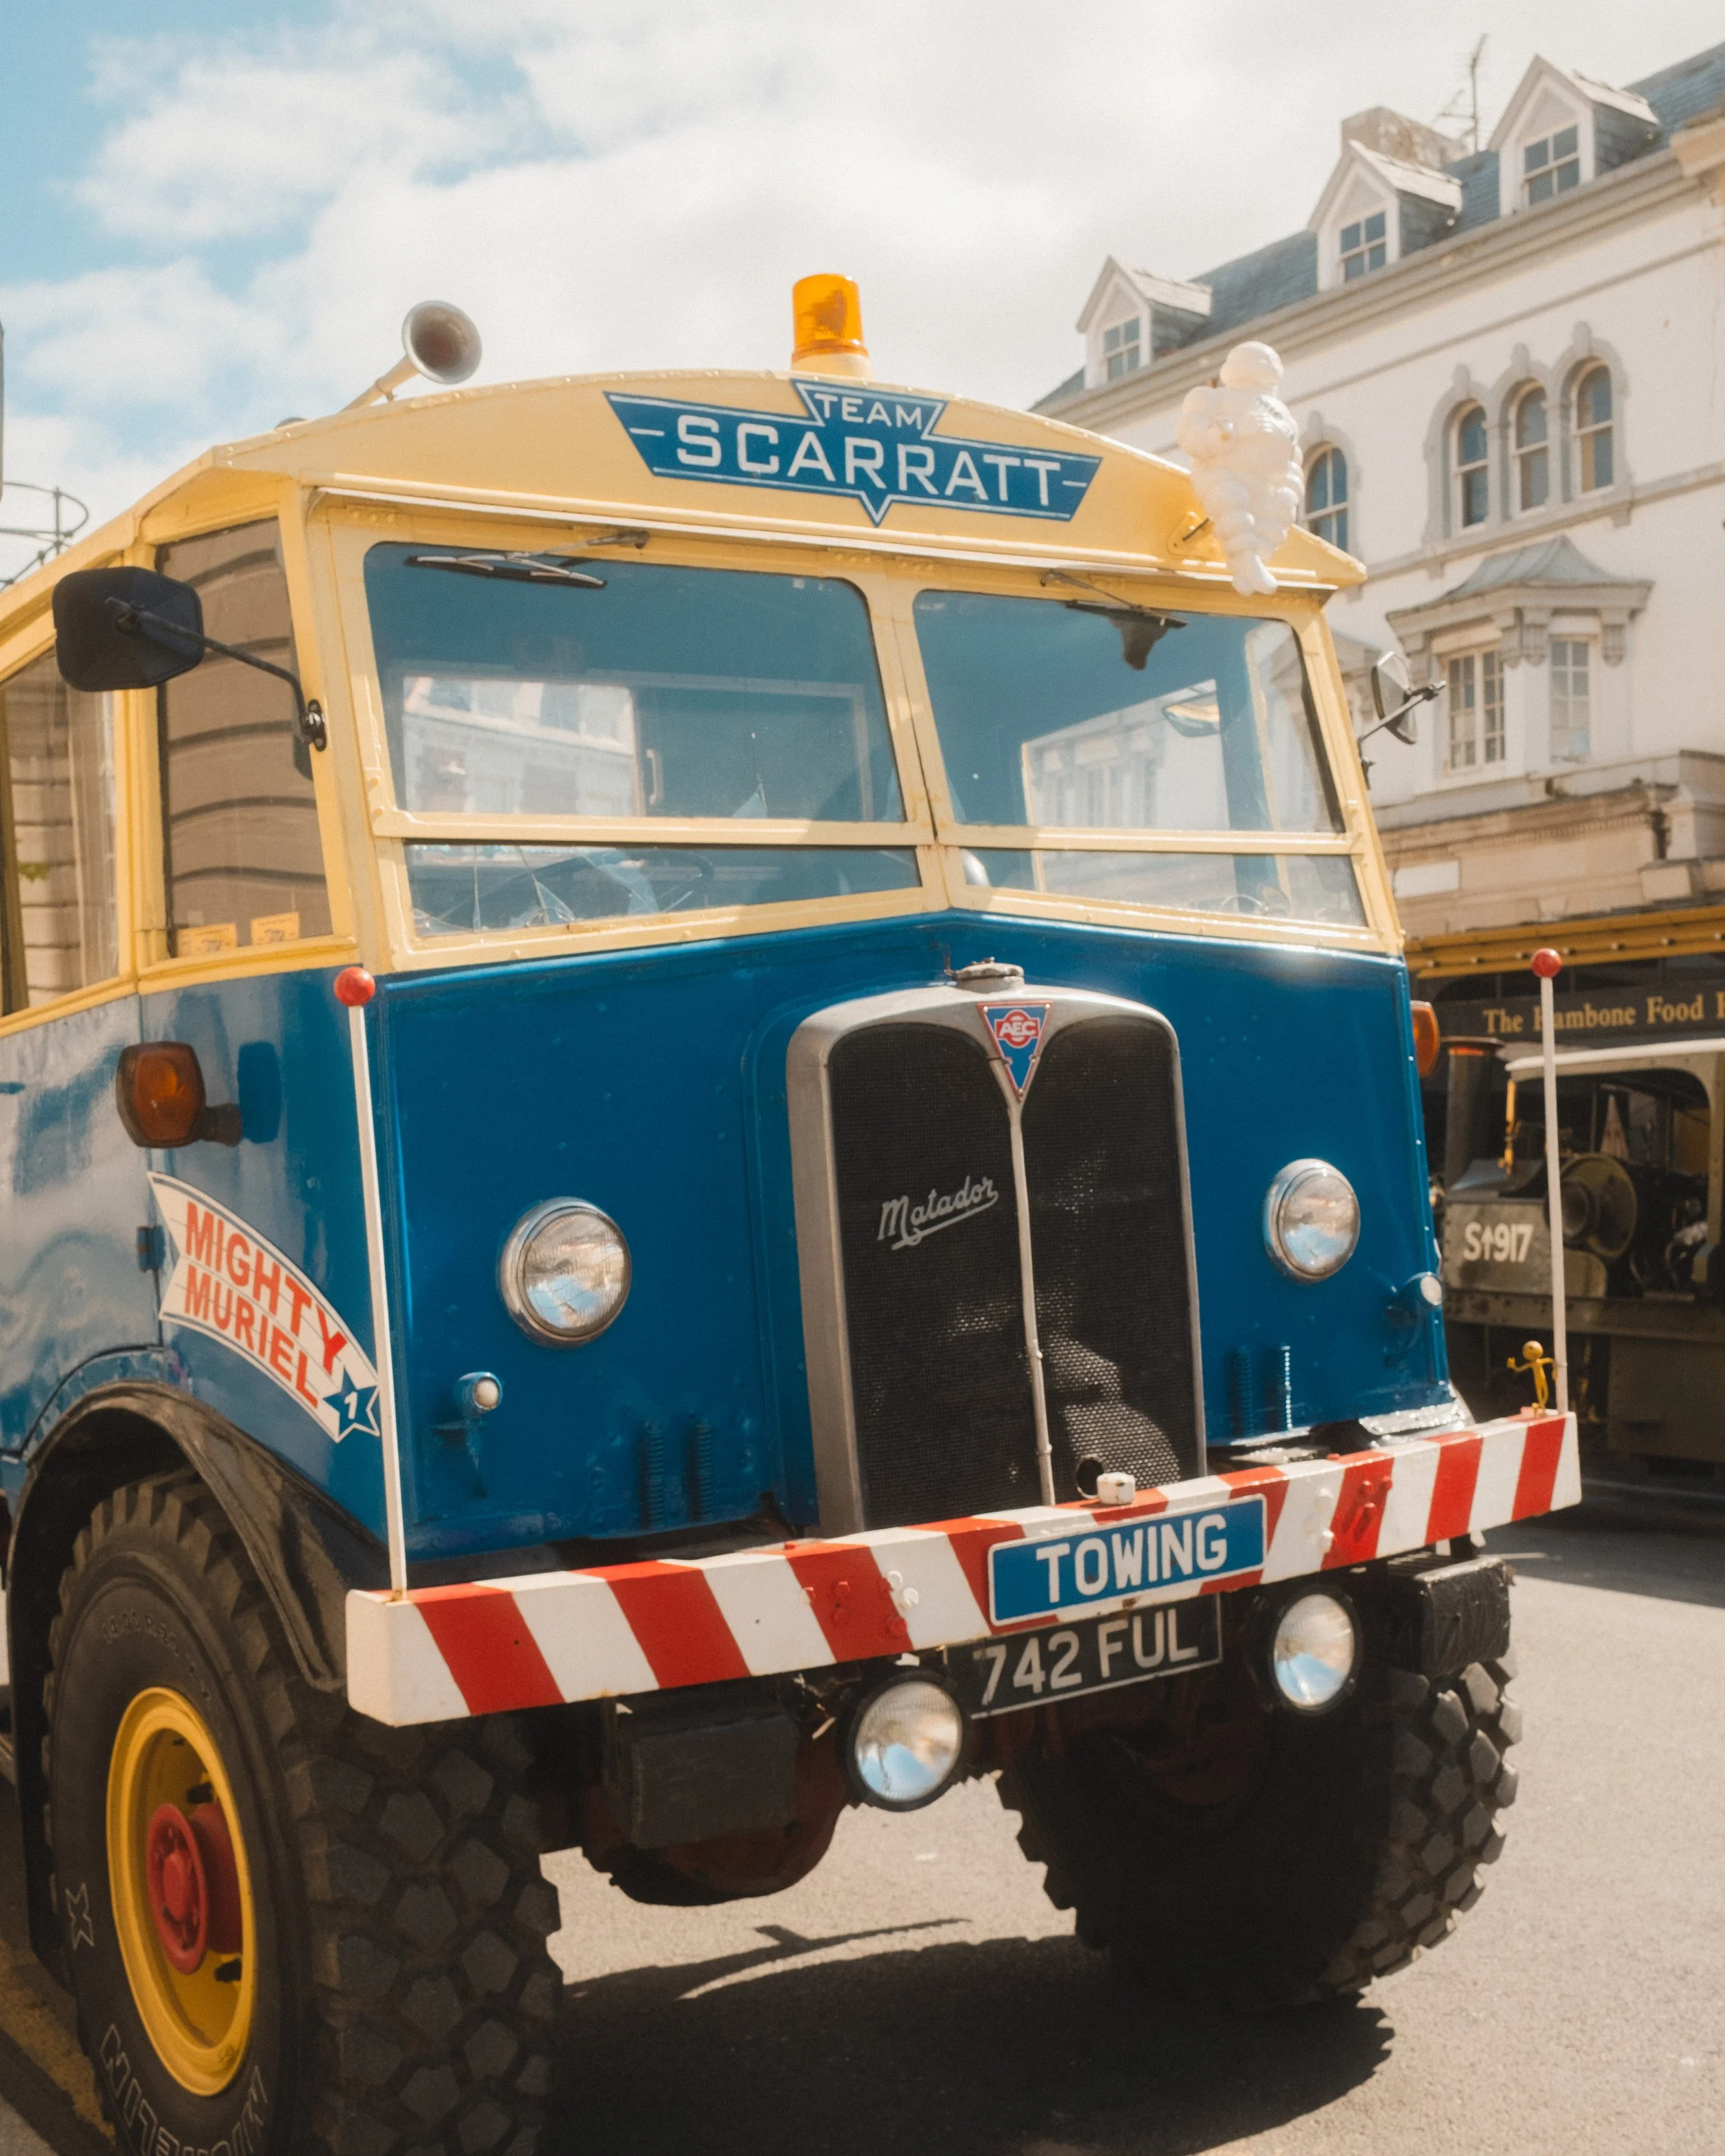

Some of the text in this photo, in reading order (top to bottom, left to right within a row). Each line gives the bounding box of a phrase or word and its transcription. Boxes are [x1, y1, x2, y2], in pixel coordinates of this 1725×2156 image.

[813, 392, 923, 431] TEAM
[676, 414, 1061, 506] SCARRATT
[998, 1020, 1036, 1037] AEC
[1482, 1007, 1524, 1034] The
[1646, 993, 1704, 1025] Food
[876, 1176, 999, 1250] Matador
[185, 1200, 347, 1376] MIGHTY
[184, 1264, 319, 1409] MURIEL
[344, 1391, 358, 1420] 1
[1036, 1514, 1228, 1603] TOWING
[972, 1608, 1199, 1706] 742 FUL
